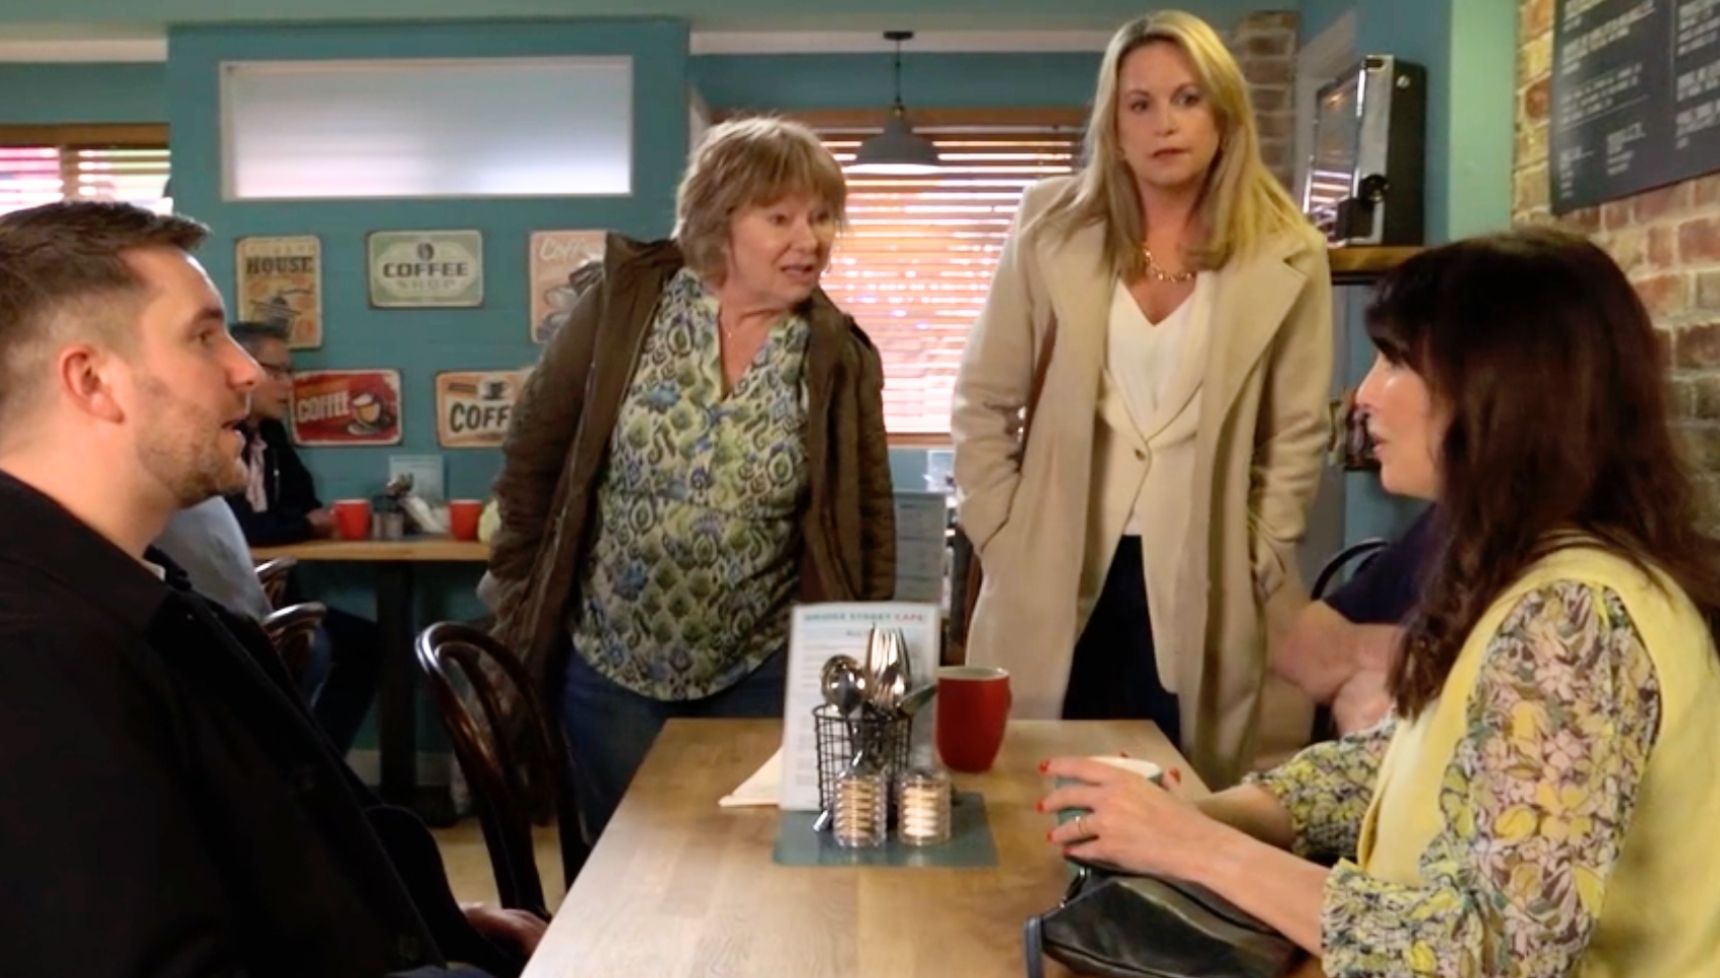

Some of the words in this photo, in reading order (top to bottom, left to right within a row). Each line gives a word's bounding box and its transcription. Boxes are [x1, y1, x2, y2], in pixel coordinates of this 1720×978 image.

[246, 256, 313, 274] HOUSE
[383, 262, 469, 278] COFFEE
[297, 390, 349, 422] COFFEE
